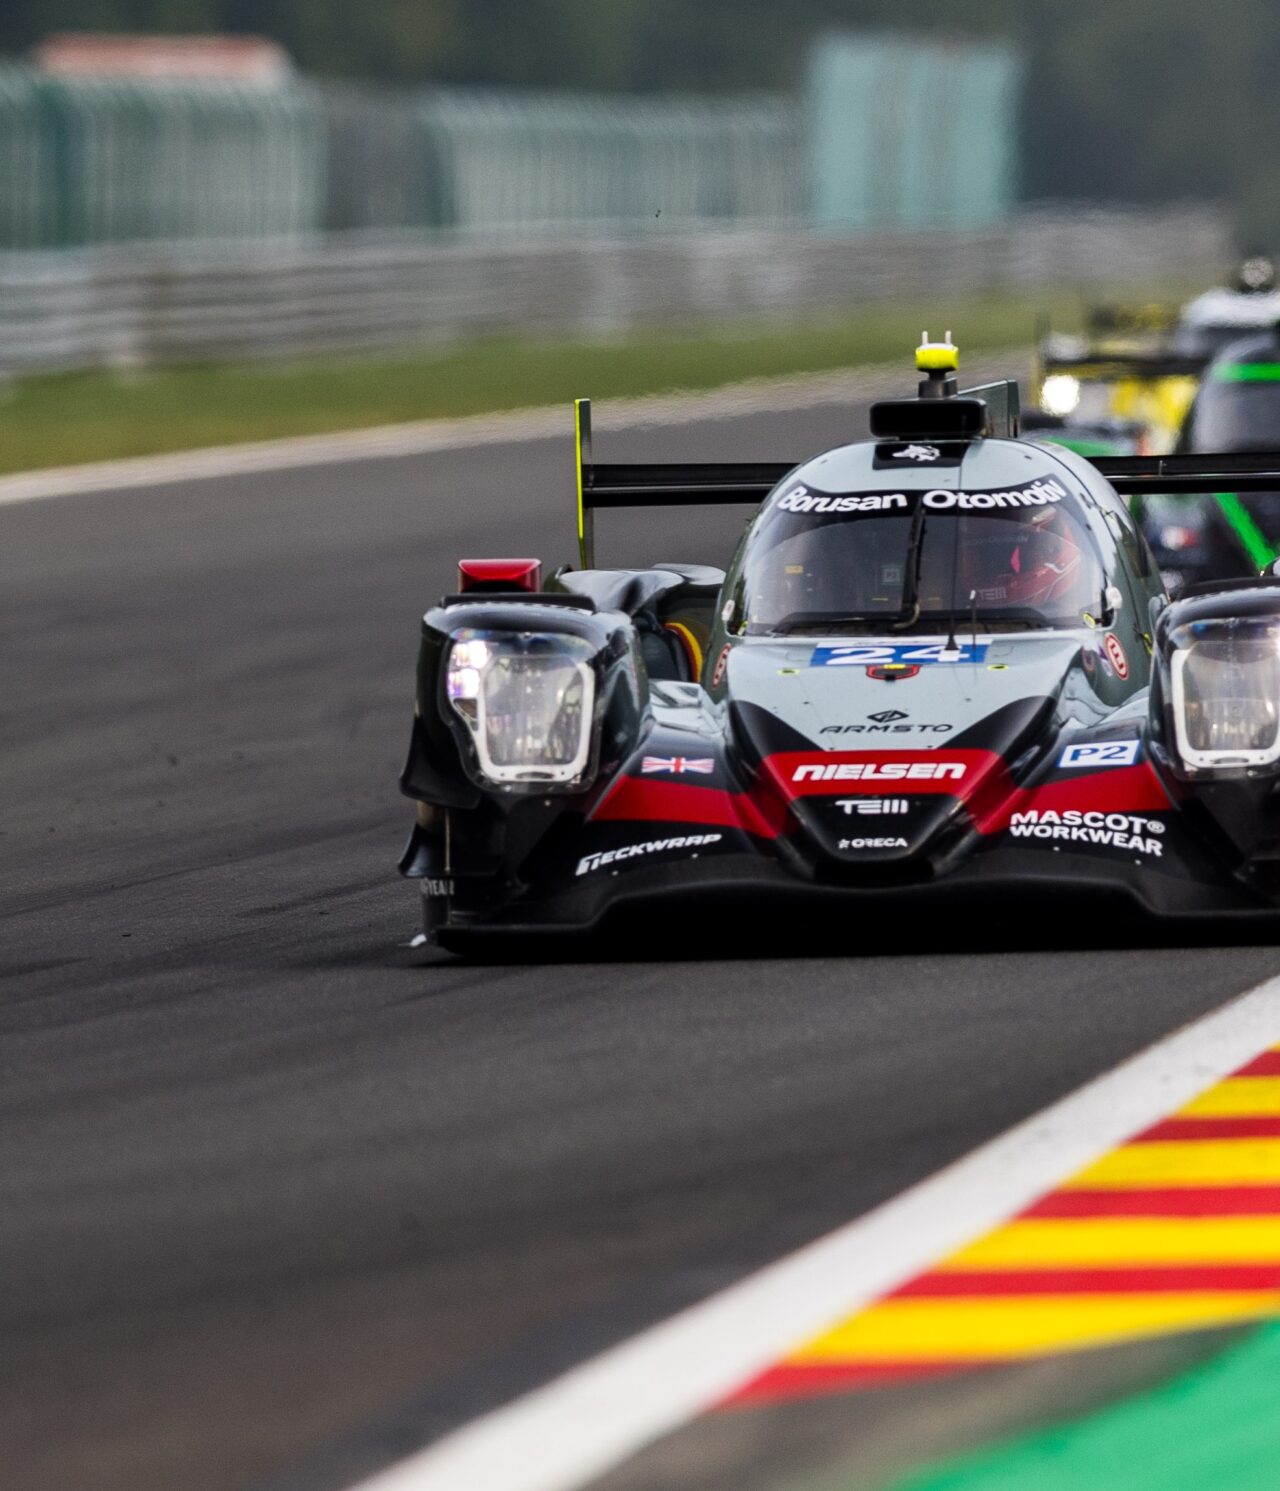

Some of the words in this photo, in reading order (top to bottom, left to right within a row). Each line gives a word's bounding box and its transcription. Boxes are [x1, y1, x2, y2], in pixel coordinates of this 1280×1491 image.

[777, 485, 908, 514] Borusan
[921, 479, 1069, 510] Otomotiv
[825, 644, 971, 666] 24
[818, 723, 954, 735] ARMSTO
[1069, 745, 1129, 762] P2
[792, 762, 968, 782] NIELSEN
[851, 837, 908, 849] ORECA
[1009, 824, 1164, 857] WORKWEAR
